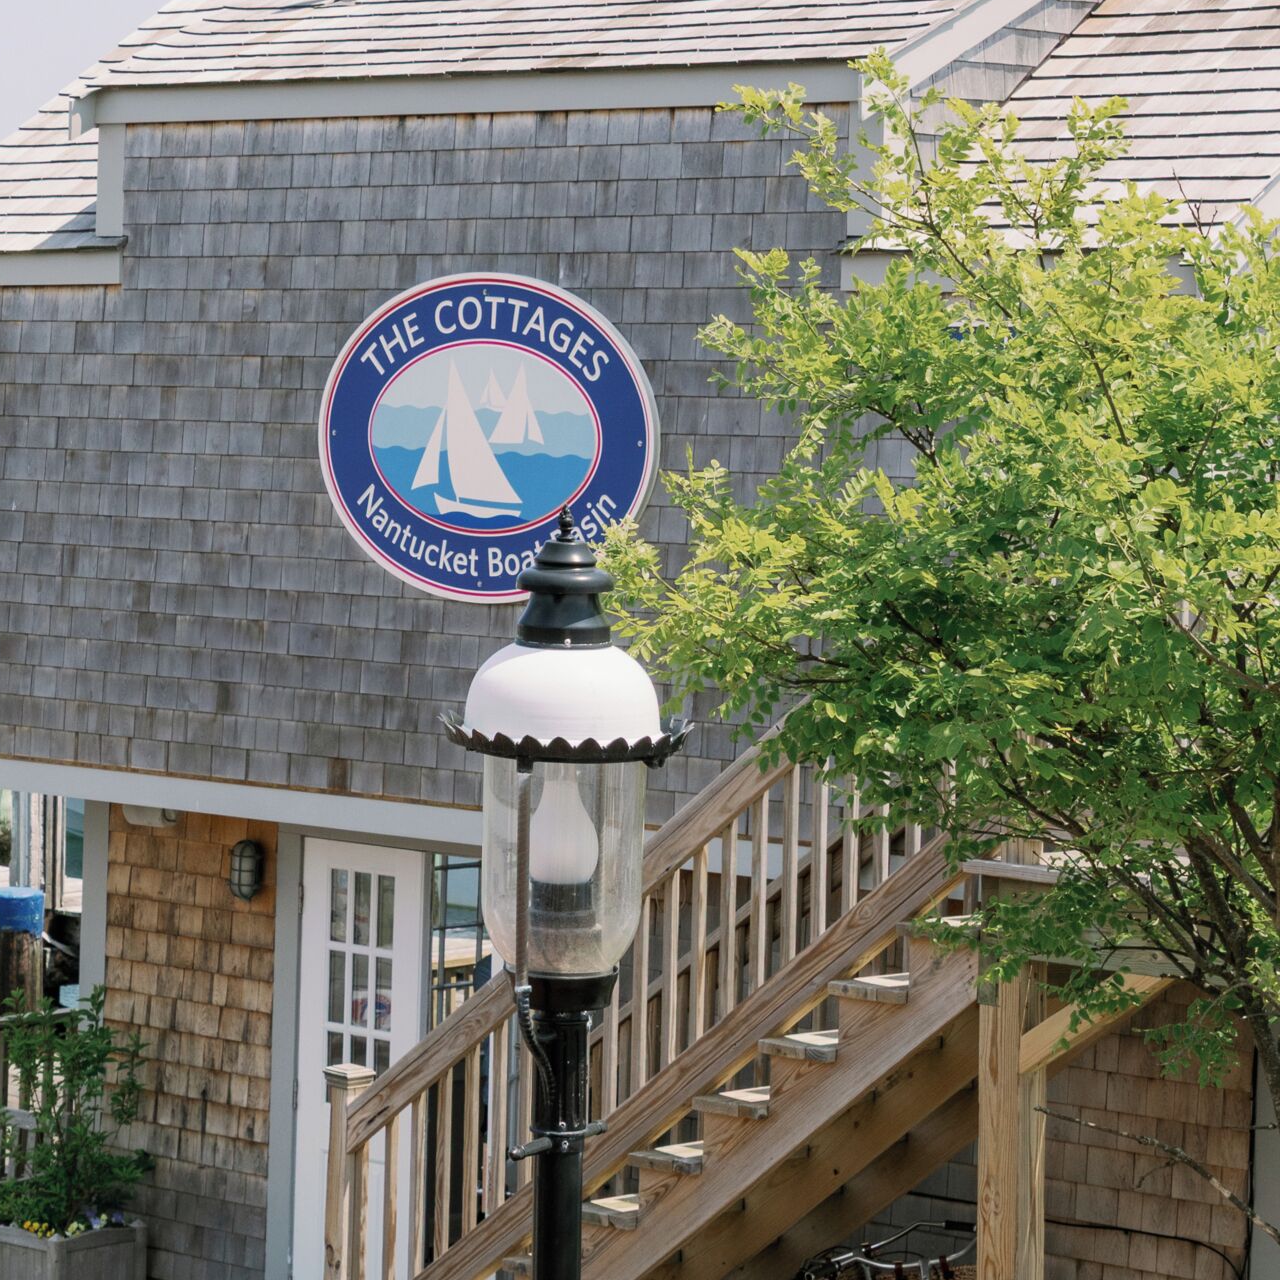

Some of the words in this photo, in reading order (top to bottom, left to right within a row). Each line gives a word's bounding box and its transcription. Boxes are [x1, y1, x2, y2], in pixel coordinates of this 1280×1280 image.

[360, 312, 425, 376] THE
[434, 296, 610, 382] COTTAGES
[356, 483, 478, 577] Nantucket
